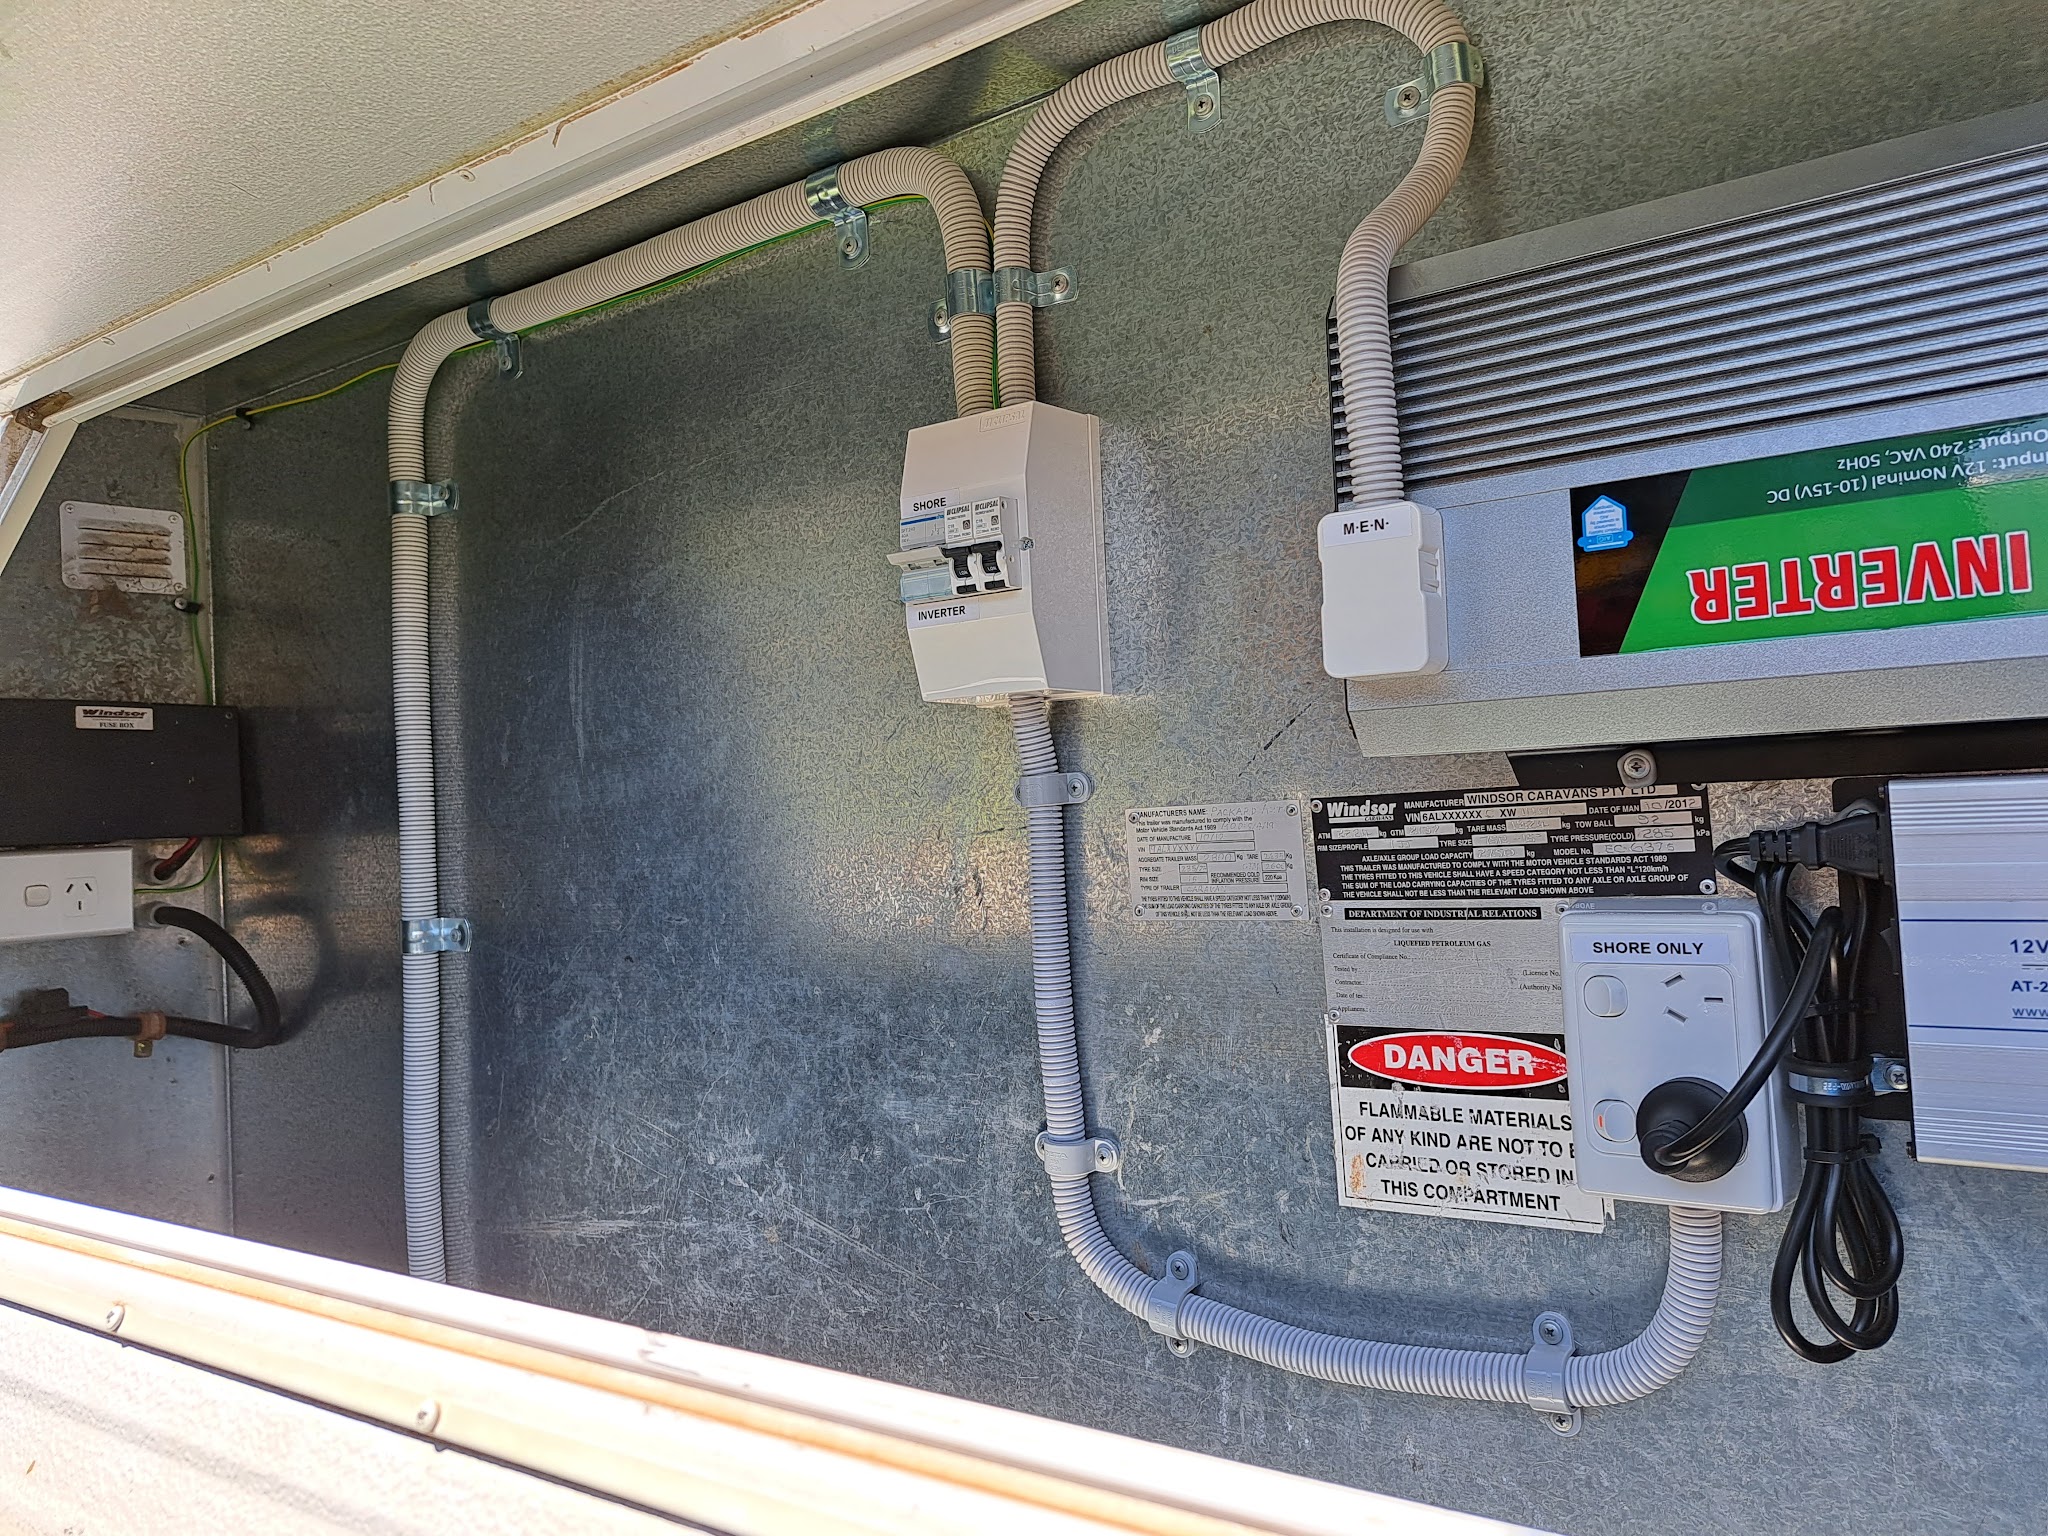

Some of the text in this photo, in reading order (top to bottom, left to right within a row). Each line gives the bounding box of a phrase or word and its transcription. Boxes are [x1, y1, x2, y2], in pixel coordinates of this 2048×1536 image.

[1885, 446, 1926, 468] VAC,
[1930, 440, 1964, 462] 240
[1837, 454, 1881, 472] 50Hz
[1952, 459, 1986, 478] 12V
[1871, 465, 1947, 490] Nominal
[1794, 474, 1867, 501] (10-15V)
[1767, 489, 1790, 504] DC
[913, 498, 946, 512] SHORE
[979, 500, 998, 510] CLIPSAL
[1685, 530, 2034, 625] INVERTER
[918, 606, 966, 620] INVERTER
[82, 708, 147, 718] Windsor
[1404, 798, 1464, 809] MANUFACTURER
[1467, 793, 1524, 804] WINDSOR
[1527, 788, 1598, 801] CARAVANS
[1602, 787, 1626, 797] PTY
[1327, 800, 1396, 817] Windsor
[1405, 813, 1420, 822] VIN
[1422, 810, 1482, 822] 6ALXXXXXX
[1500, 808, 1516, 817] XW
[1562, 821, 1570, 829] kg
[1694, 816, 1704, 824] kg
[1379, 830, 1386, 838] kg
[1570, 833, 1634, 842] PRESSURE(COLD)
[1696, 829, 1710, 837] kPa
[1526, 850, 1535, 858] kg
[1355, 864, 1381, 872] TRAILER
[1382, 863, 1396, 871] WAS
[1398, 862, 1451, 870] MANUFACTURED
[1452, 861, 1461, 869] TO
[1463, 860, 1490, 868] COMPLY
[1510, 859, 1525, 867] THE
[1526, 858, 1552, 866] MOTOR
[1553, 857, 1584, 865] VEHICLE
[1586, 856, 1631, 864] STANDARDS
[1633, 855, 1648, 863] ACT
[1341, 873, 1353, 881] THE
[1376, 872, 1397, 880] FITTED
[1408, 871, 1422, 879] THIS
[1476, 869, 1494, 877] HAVE
[1502, 868, 1525, 876] SPEED
[1527, 867, 1566, 875] CATEGORY
[1604, 865, 1625, 873] THAN
[1412, 880, 1445, 888] CARRYING
[1447, 879, 1486, 887] CAPACITIES
[1538, 877, 1562, 885] FITTED
[1626, 875, 1646, 883] AXLE
[1519, 887, 1538, 895] LOAD
[1568, 886, 1594, 894] ABOVE
[1348, 909, 1537, 918] DEPARTMENT OF INDUSTRIAL RELATIONS
[1592, 942, 1704, 955] SHORE ONLY
[1383, 1044, 1535, 1076] DANGER
[1360, 1102, 1572, 1132] FLAMMABLE MATERIALS
[1345, 1126, 1366, 1141] OF
[1372, 1128, 1404, 1144] ANY
[1410, 1130, 1450, 1148] KIND
[1457, 1136, 1492, 1152] ARE
[1498, 1139, 1534, 1155] NOT
[1538, 1142, 1562, 1158] TO
[1366, 1152, 1573, 1185] CARRIED OR STORED IN
[1381, 1179, 1560, 1212] THIS COMPARTMENT
